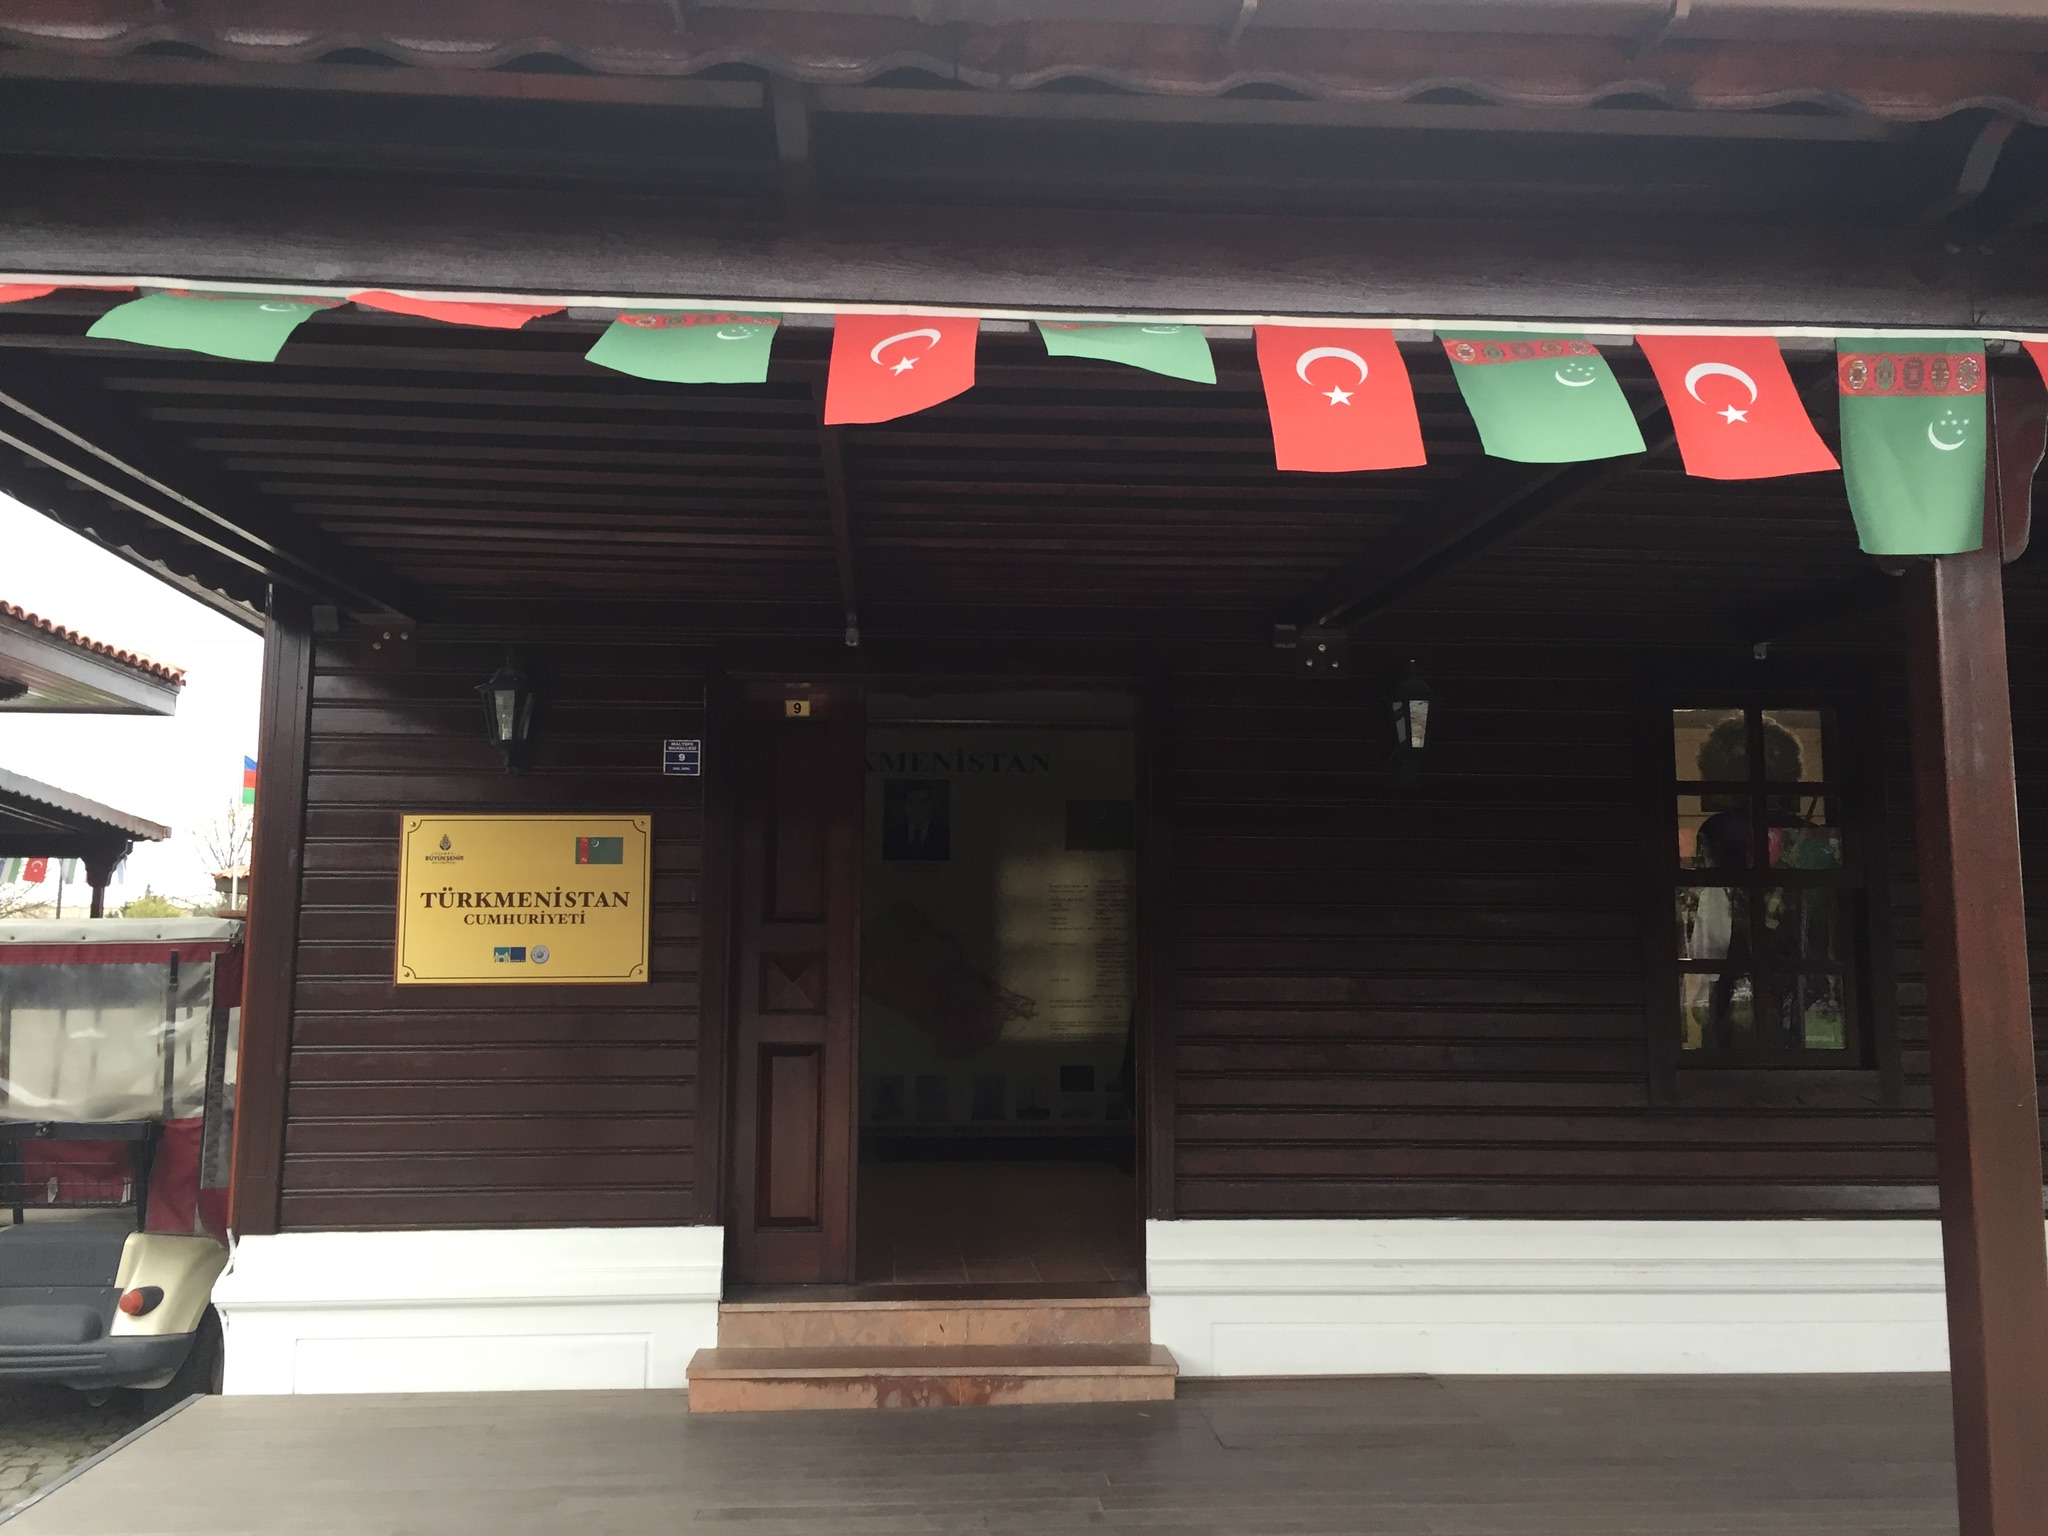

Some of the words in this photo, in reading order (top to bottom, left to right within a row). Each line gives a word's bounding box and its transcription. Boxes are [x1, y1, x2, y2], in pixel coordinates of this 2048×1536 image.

[793, 702, 802, 714] 9
[678, 753, 686, 762] 9
[421, 886, 631, 909] TÜRKMENİSTAN
[463, 910, 586, 925] CUMHURİYETİ
